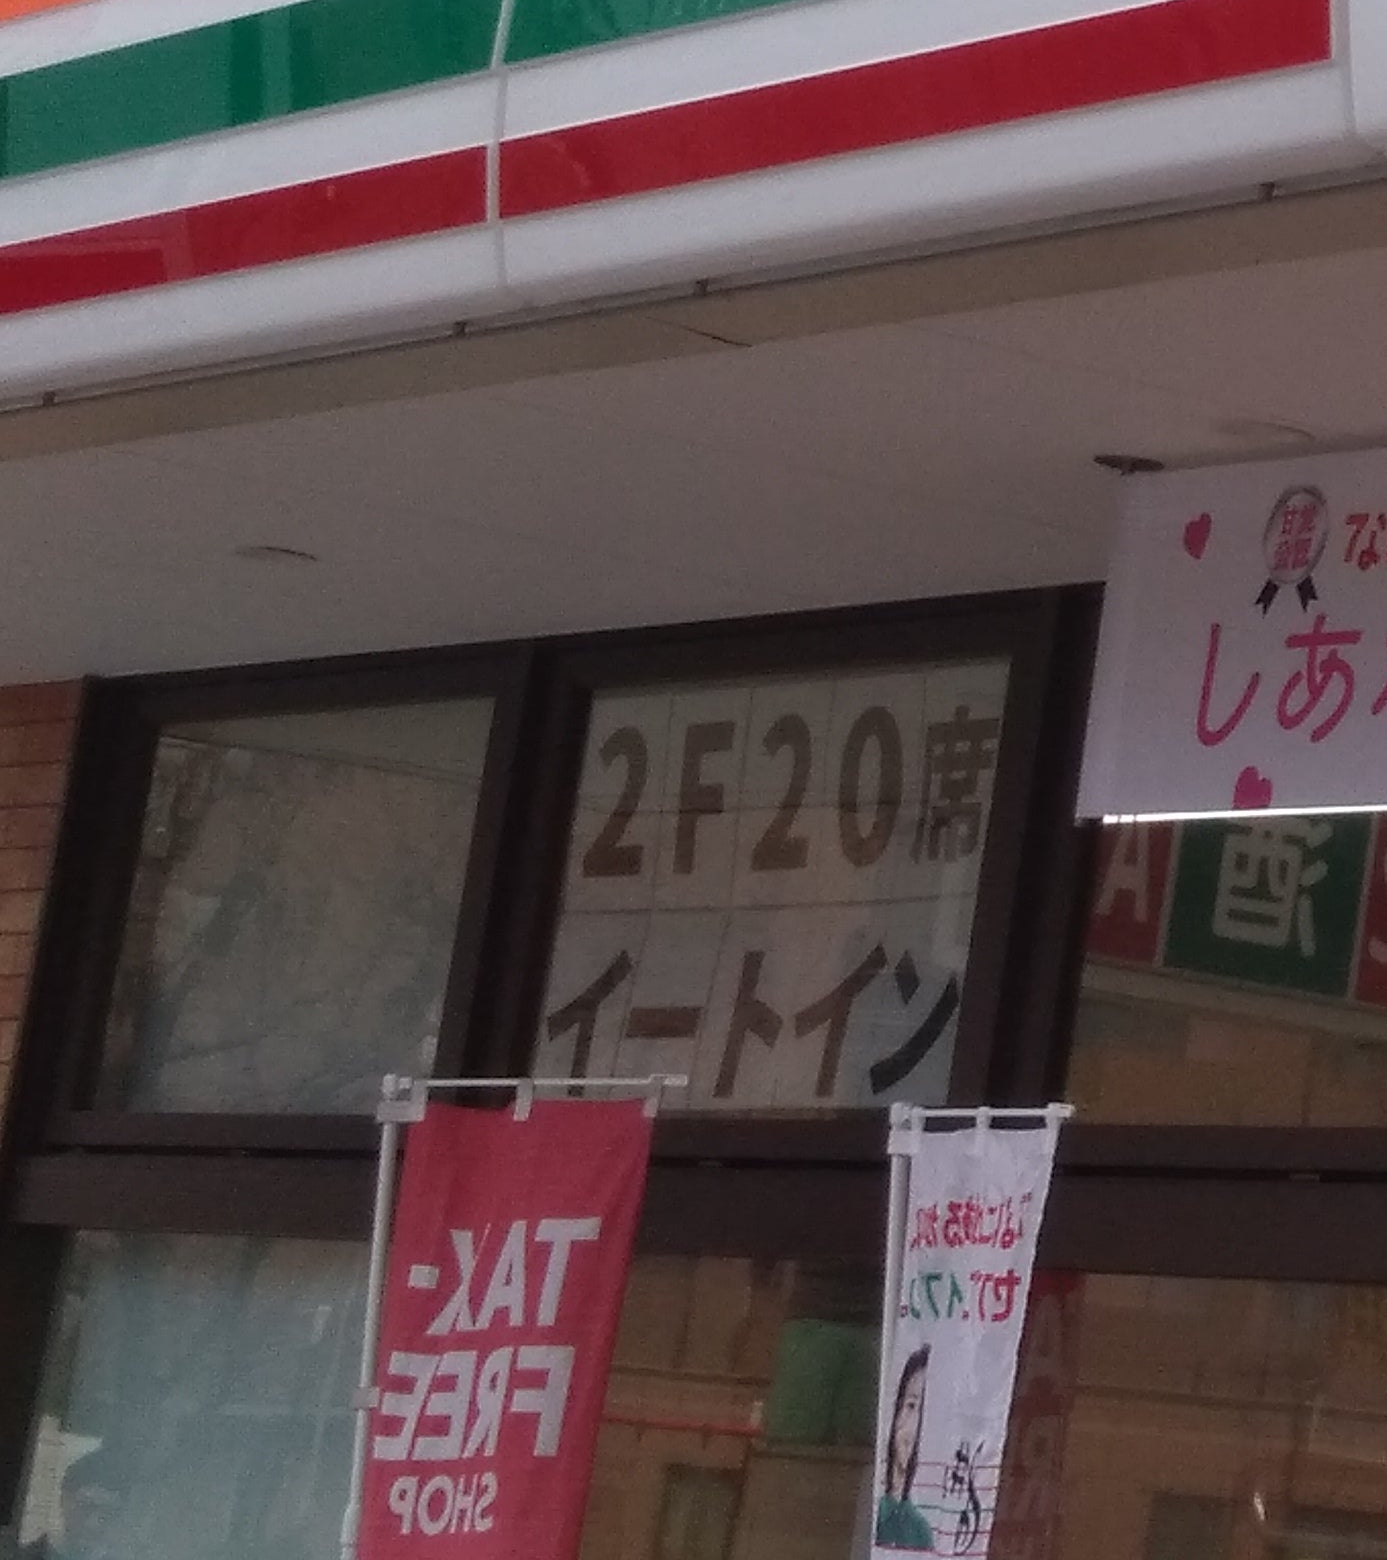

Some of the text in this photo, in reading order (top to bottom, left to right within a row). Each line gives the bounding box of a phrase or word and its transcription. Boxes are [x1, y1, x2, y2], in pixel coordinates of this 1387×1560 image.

[582, 705, 1000, 877] 2F20席
[546, 944, 959, 1099] イートイン
